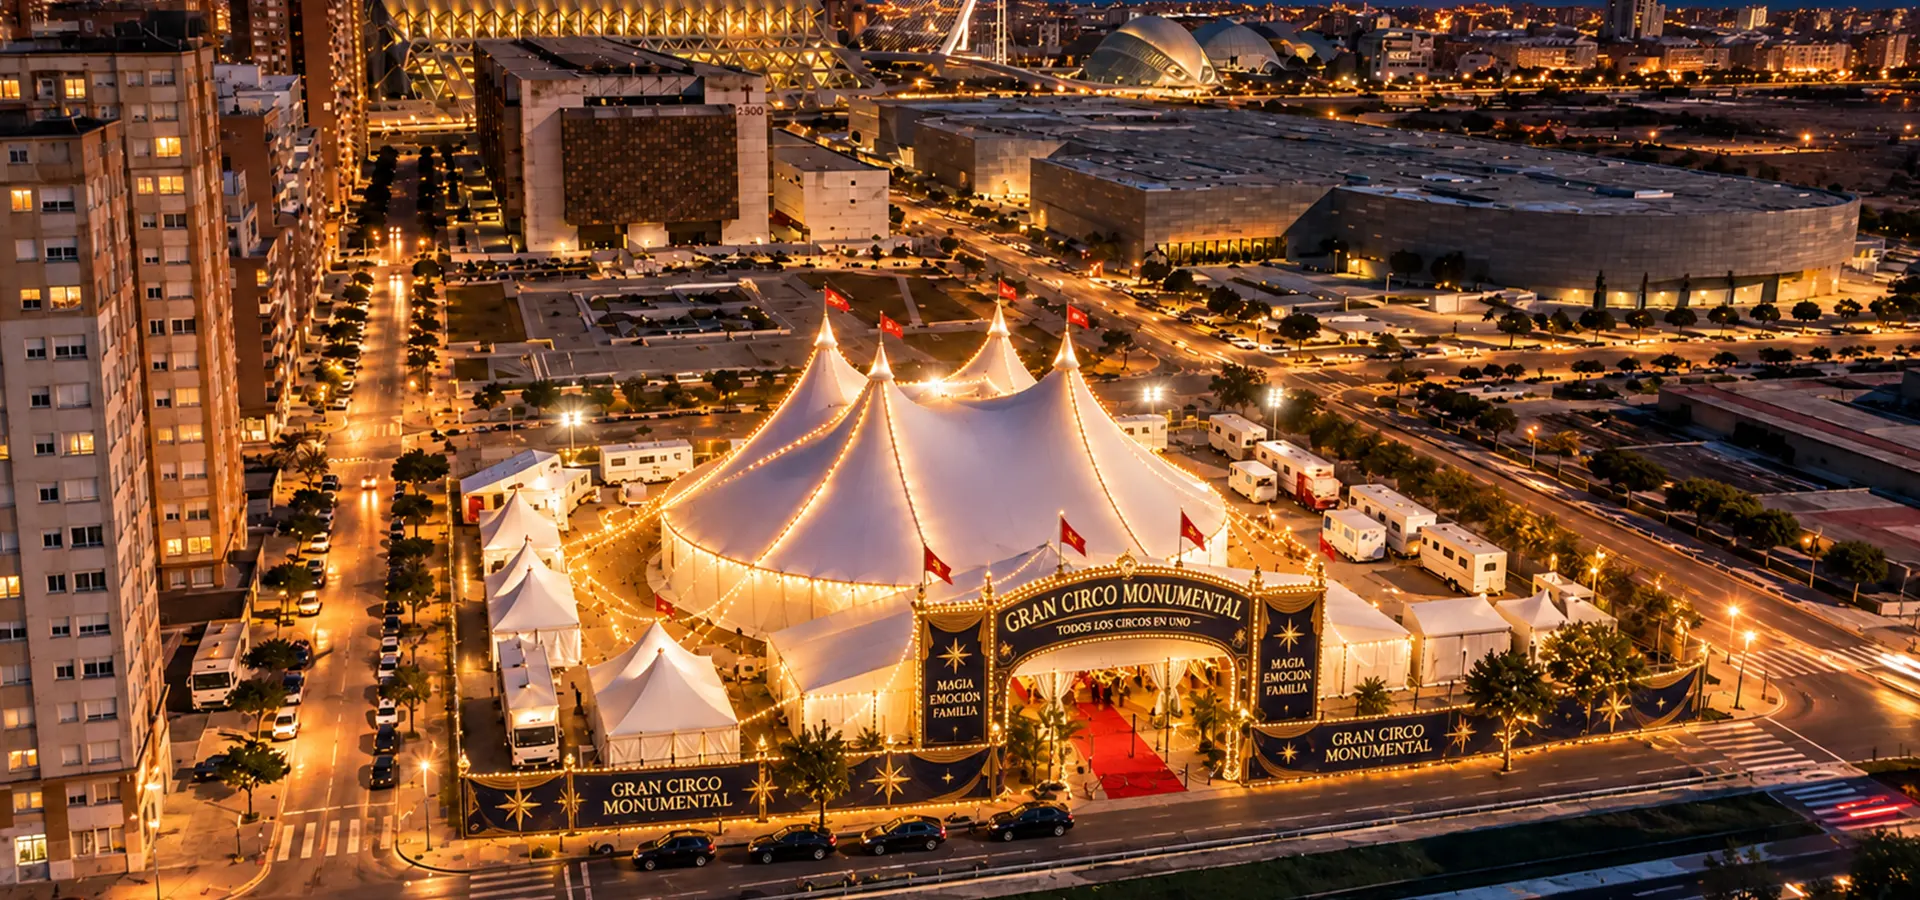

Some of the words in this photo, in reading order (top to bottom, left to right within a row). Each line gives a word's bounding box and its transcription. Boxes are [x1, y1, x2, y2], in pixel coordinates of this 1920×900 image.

[737, 106, 764, 116] 2500
[1005, 597, 1057, 632] GRAN
[1061, 584, 1118, 614] CIRCO
[1122, 583, 1242, 621] MONUMENTAL
[1056, 622, 1092, 636] TODOS
[1094, 619, 1114, 631] LOS
[1115, 616, 1152, 628] CIRCOS
[1153, 616, 1167, 627] EN
[1169, 617, 1191, 627] UNO
[1271, 657, 1305, 669] MAGIA
[937, 678, 974, 691] MAGIA
[1266, 683, 1308, 696] FAMILIA
[933, 705, 978, 718] FAMILIA
[1332, 729, 1375, 746] GRAN
[1378, 724, 1425, 741] CIRCO
[1324, 739, 1433, 763] MONUMENTAL
[611, 780, 662, 798] GRAN
[666, 776, 722, 794] CIRCO
[603, 792, 733, 815] MONUMENTAL
